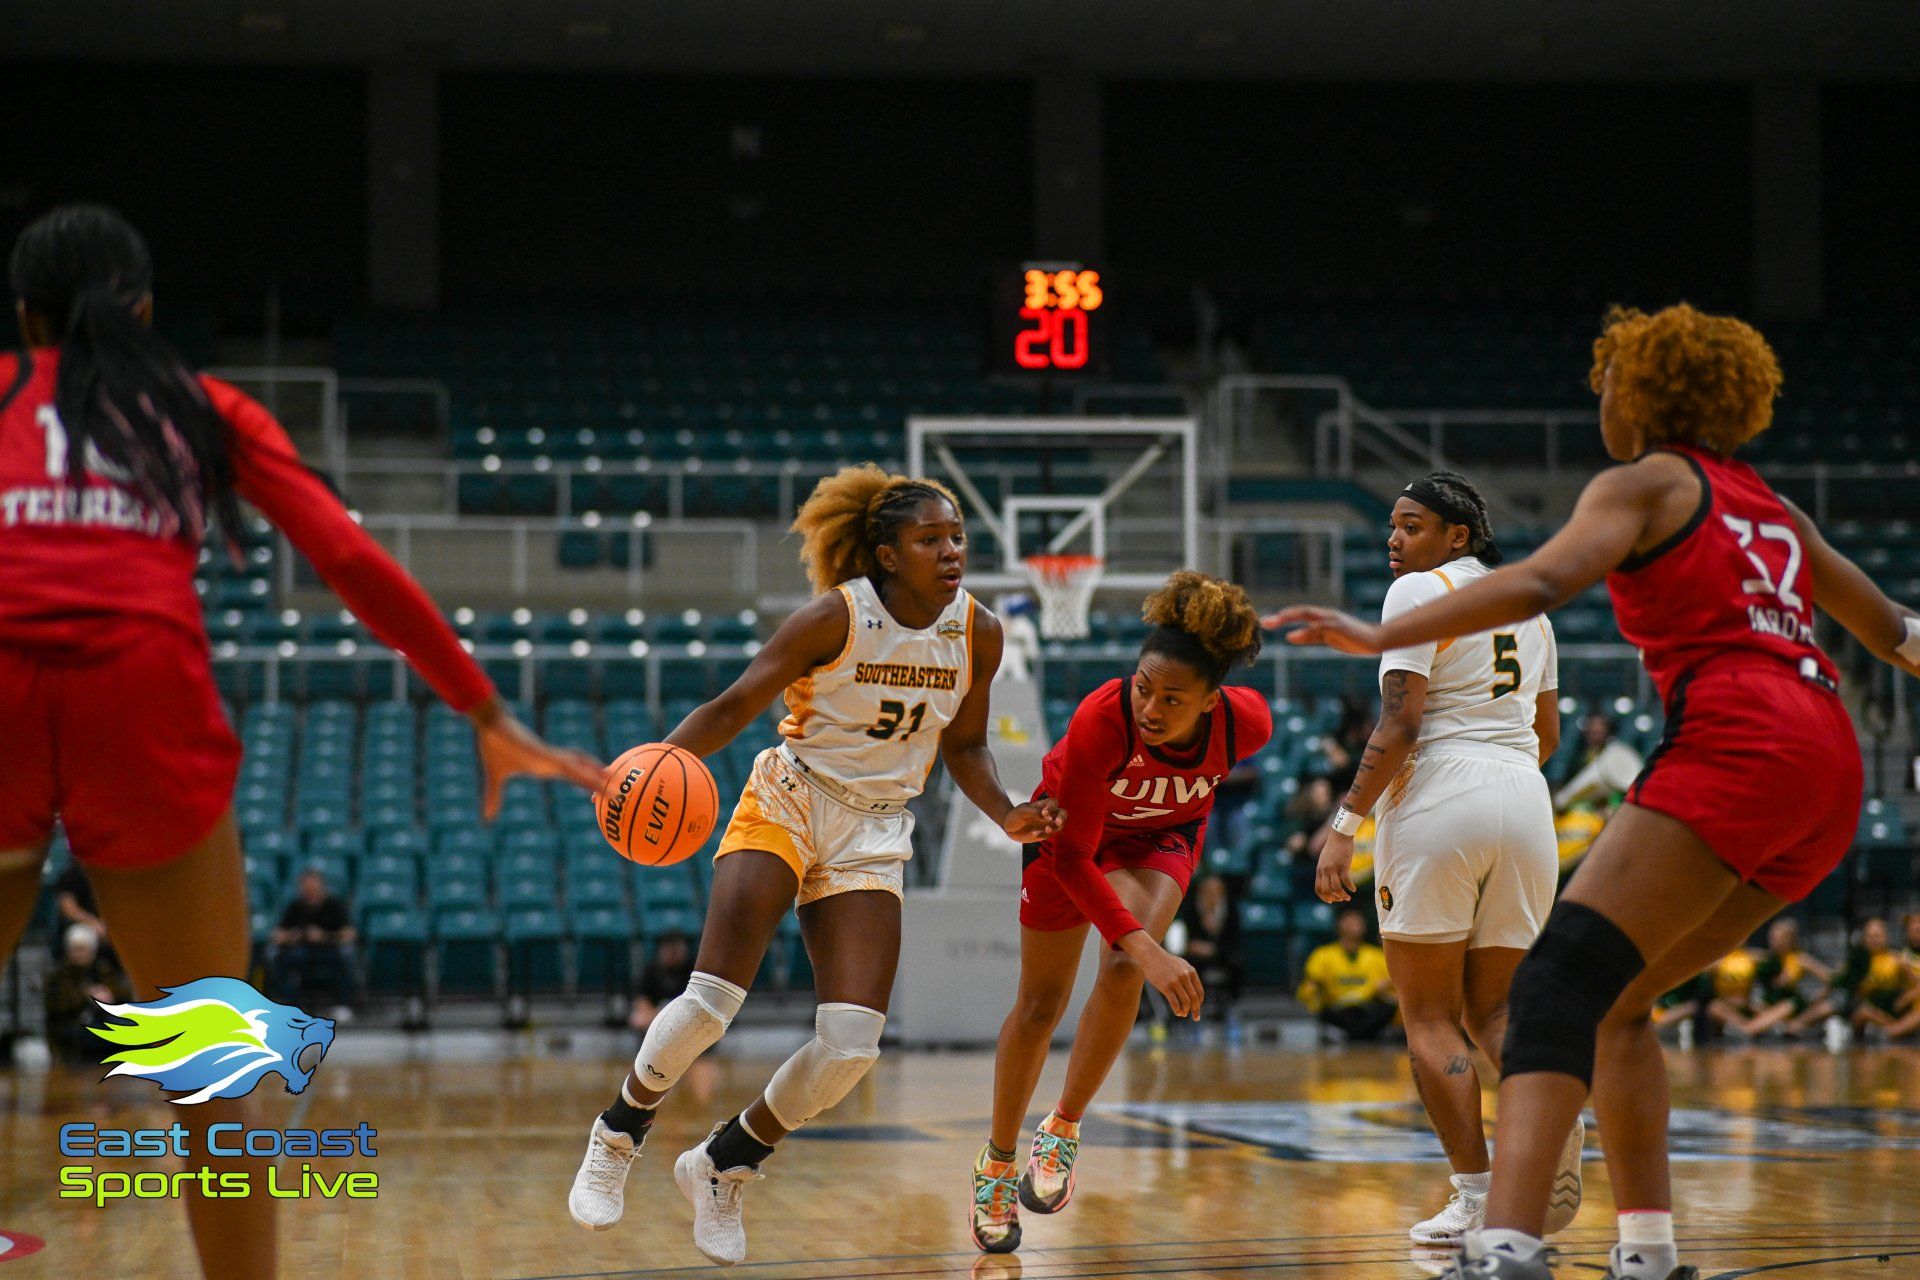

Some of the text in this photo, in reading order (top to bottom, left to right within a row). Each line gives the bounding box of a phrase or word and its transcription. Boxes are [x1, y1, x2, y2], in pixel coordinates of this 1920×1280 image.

[1024, 269, 1103, 311] 3:55
[1015, 306, 1089, 369] 20
[1720, 513, 1805, 613] 32
[854, 661, 959, 692] SOUTHEASTERN
[1490, 632, 1522, 701] 5
[864, 699, 928, 743] 31
[605, 766, 646, 843] Wilson
[1110, 774, 1222, 805] UIW
